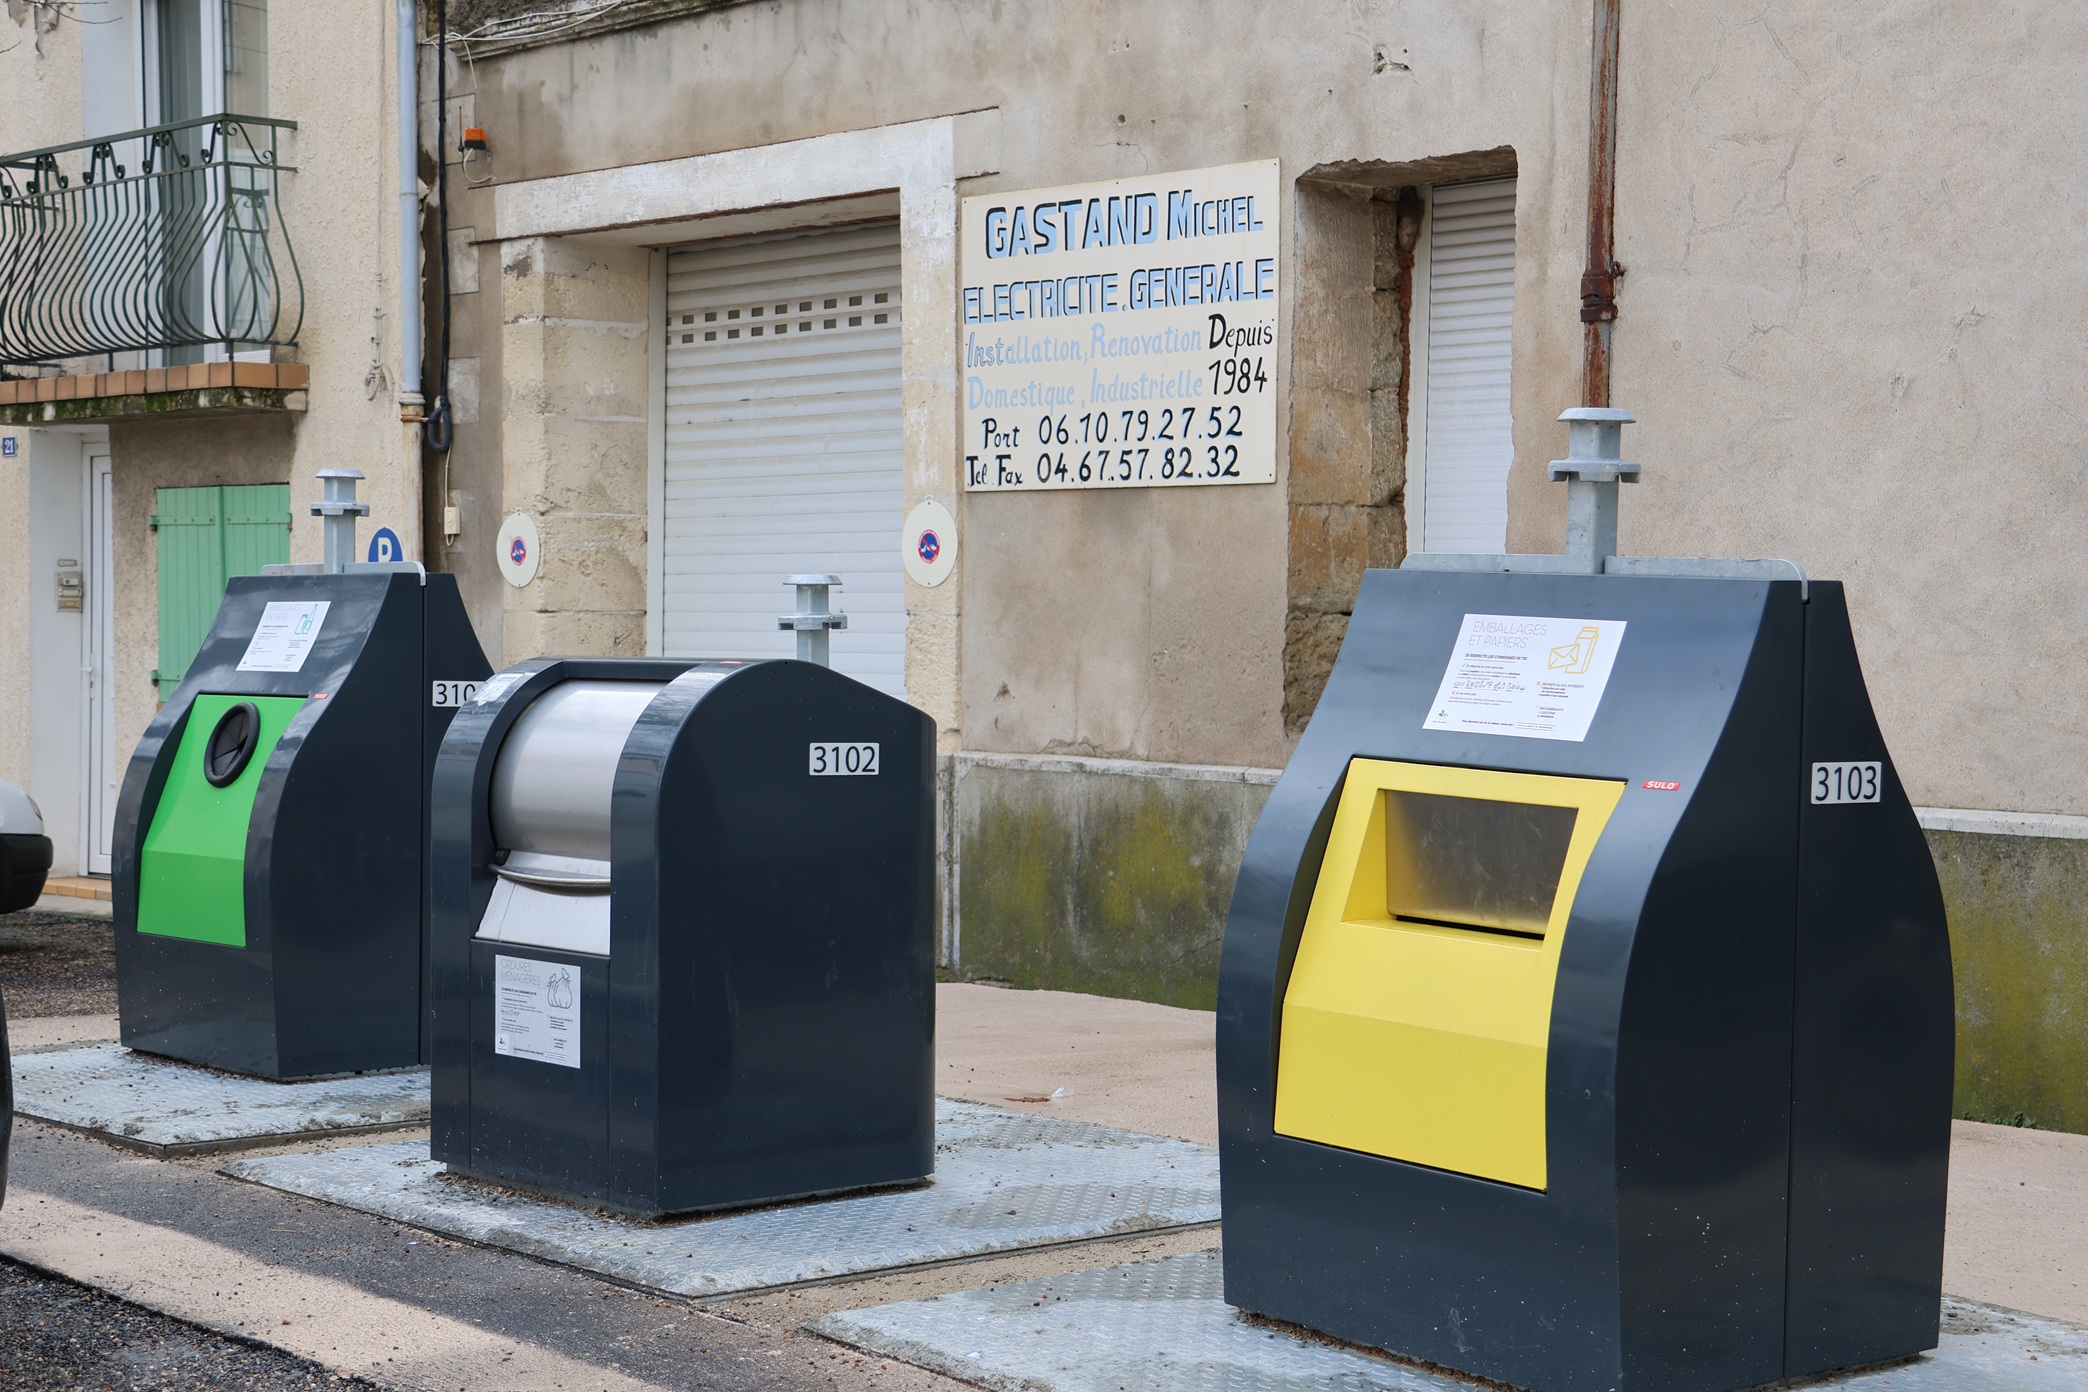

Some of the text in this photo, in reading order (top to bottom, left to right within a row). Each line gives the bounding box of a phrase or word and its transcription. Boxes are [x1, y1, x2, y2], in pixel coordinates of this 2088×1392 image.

[985, 192, 1159, 259] GASTAND
[1130, 258, 1275, 311] GENERALE
[966, 322, 1203, 368] Installation, Renovation
[1208, 313, 1274, 357] Depuis
[1090, 367, 1204, 404] Industrielle
[1208, 356, 1268, 396] 1984
[982, 405, 1243, 449] Port 06.10.79.27.52
[5, 439, 14, 454] 21
[996, 454, 1024, 486] Fax
[378, 537, 393, 563] P
[1468, 635, 1528, 649] ET PAPIERS
[1473, 621, 1548, 636] EMBALLAGES
[436, 683, 476, 706] 310
[813, 745, 876, 773] 3102
[1646, 780, 1676, 790] SULO
[1814, 765, 1877, 801] 3103
